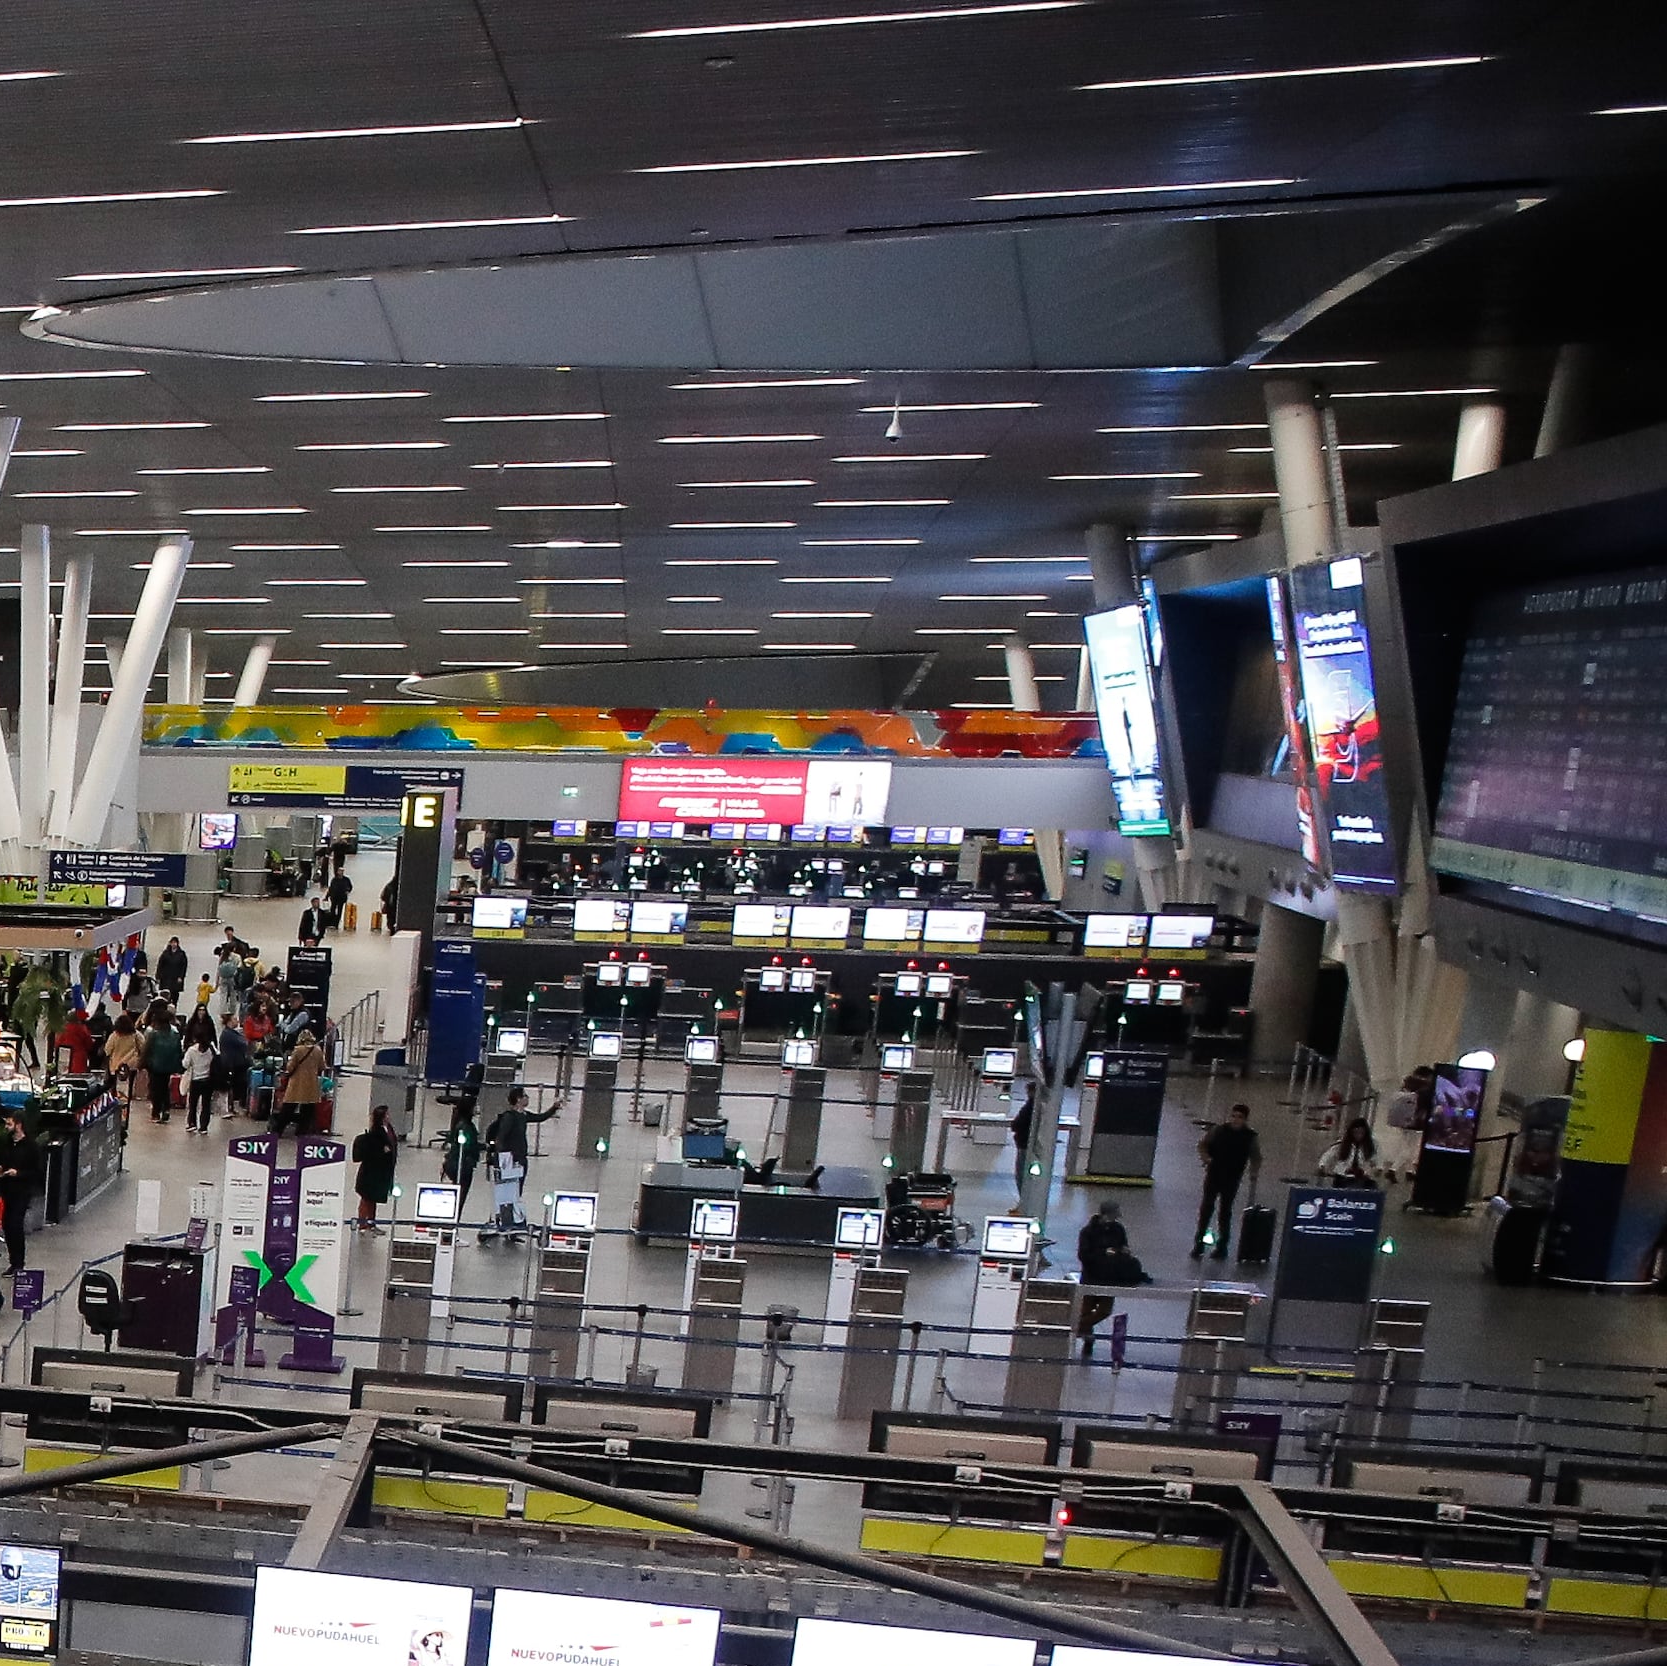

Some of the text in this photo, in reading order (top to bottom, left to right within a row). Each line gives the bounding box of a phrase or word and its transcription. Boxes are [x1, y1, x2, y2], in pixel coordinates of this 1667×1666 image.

[413, 796, 436, 829] E
[303, 1145, 338, 1160] SKY
[305, 1189, 340, 1199] Imprime
[1326, 1198, 1377, 1211] Balanza
[273, 1624, 380, 1646] NUEVOPUDAHUEL
